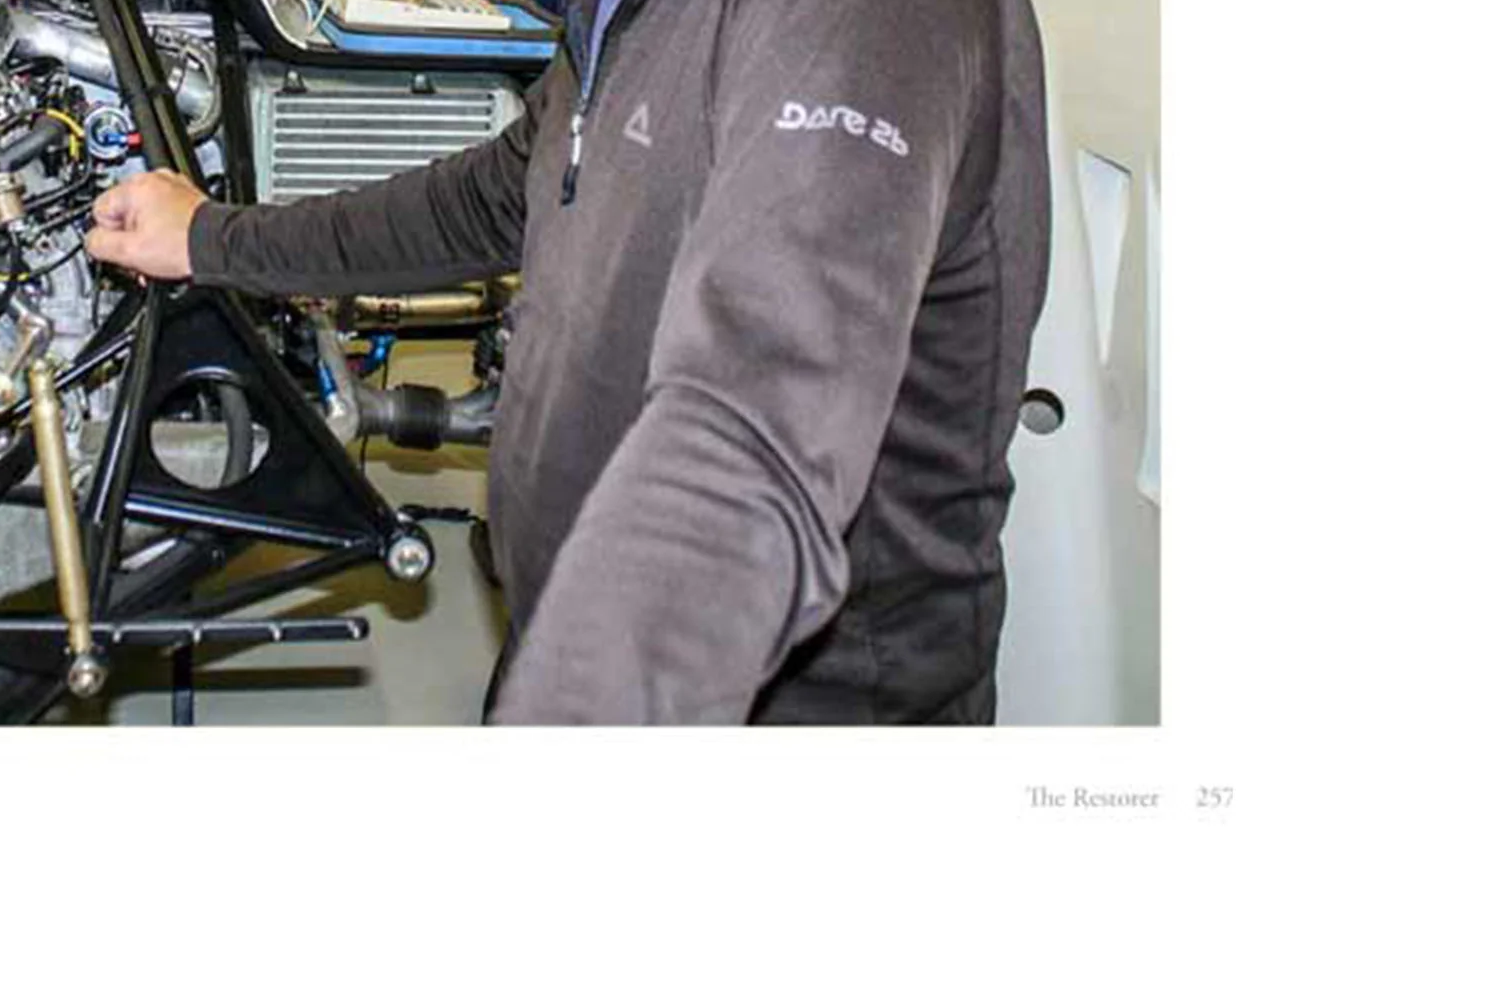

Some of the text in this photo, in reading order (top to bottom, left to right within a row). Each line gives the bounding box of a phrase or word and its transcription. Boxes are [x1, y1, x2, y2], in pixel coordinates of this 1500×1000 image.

[1026, 785, 1160, 808] The Restorer
[1196, 786, 1234, 808] 257
